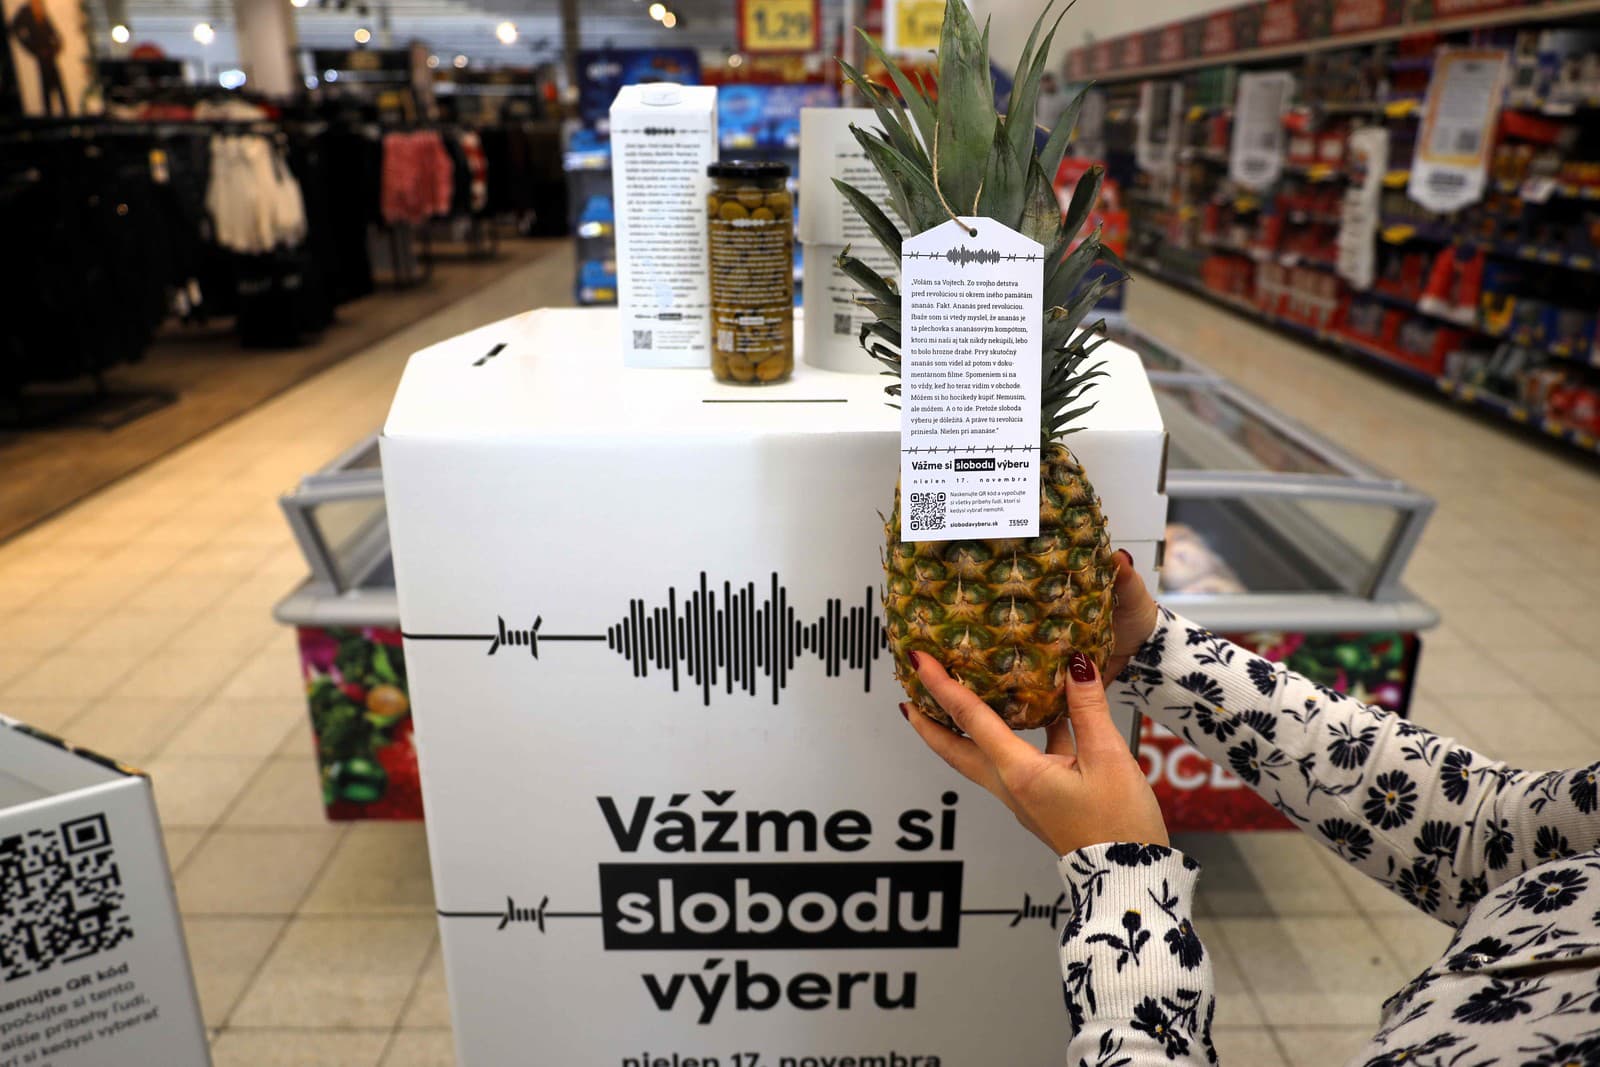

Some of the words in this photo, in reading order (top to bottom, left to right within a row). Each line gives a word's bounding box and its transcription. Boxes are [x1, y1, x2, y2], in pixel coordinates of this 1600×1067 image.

[912, 461, 942, 470] Vážme
[944, 461, 952, 470] si
[956, 460, 994, 469] slobodu
[997, 459, 1029, 471] výberu
[596, 790, 873, 853] Vážme
[895, 791, 960, 852] si
[615, 876, 945, 935] slobodu
[66, 974, 92, 991] QR
[97, 961, 130, 981] kód
[641, 958, 917, 1025] výberu
[72, 995, 86, 1008] si
[90, 980, 135, 1002] tento
[23, 1050, 38, 1064] si
[41, 1031, 94, 1056] kedysi
[97, 1006, 159, 1037] vyberať
[45, 1008, 109, 1039] príbehy
[621, 1051, 720, 1067] nielen
[778, 1050, 942, 1067] novembra
